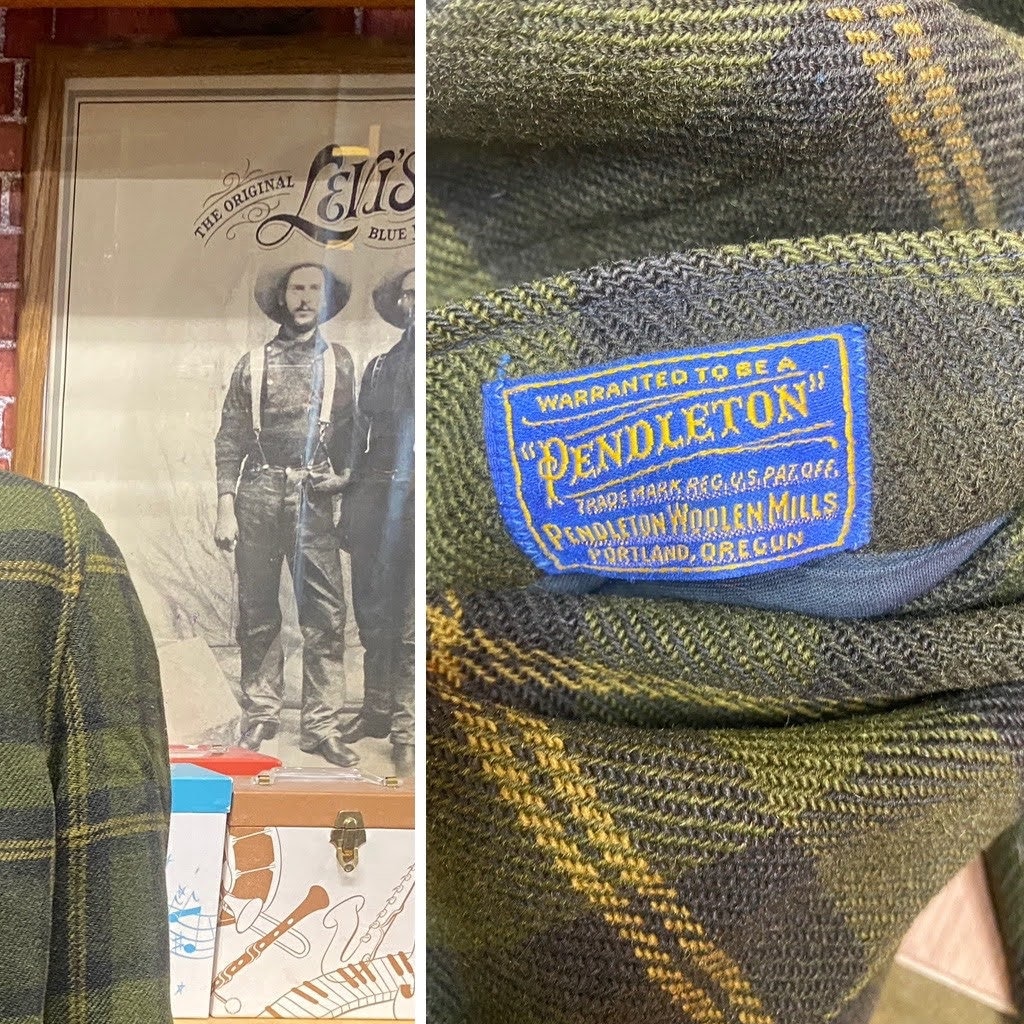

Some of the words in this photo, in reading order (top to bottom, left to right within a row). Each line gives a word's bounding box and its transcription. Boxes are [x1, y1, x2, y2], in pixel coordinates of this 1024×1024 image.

[194, 209, 223, 239] THE
[224, 174, 295, 212] ORIGINAL
[367, 226, 408, 241] BLUE
[536, 369, 689, 413] WARRANTED
[695, 364, 729, 384] TO
[735, 359, 769, 380] BE
[777, 356, 798, 373] A
[541, 511, 667, 551] PENDLETON
[666, 501, 764, 536] WOOLEN
[767, 490, 840, 524] MILLS
[576, 490, 629, 516] TRADE
[630, 479, 685, 503] MARK
[587, 543, 697, 565] PORTLAND,
[701, 530, 805, 561] OREGON
